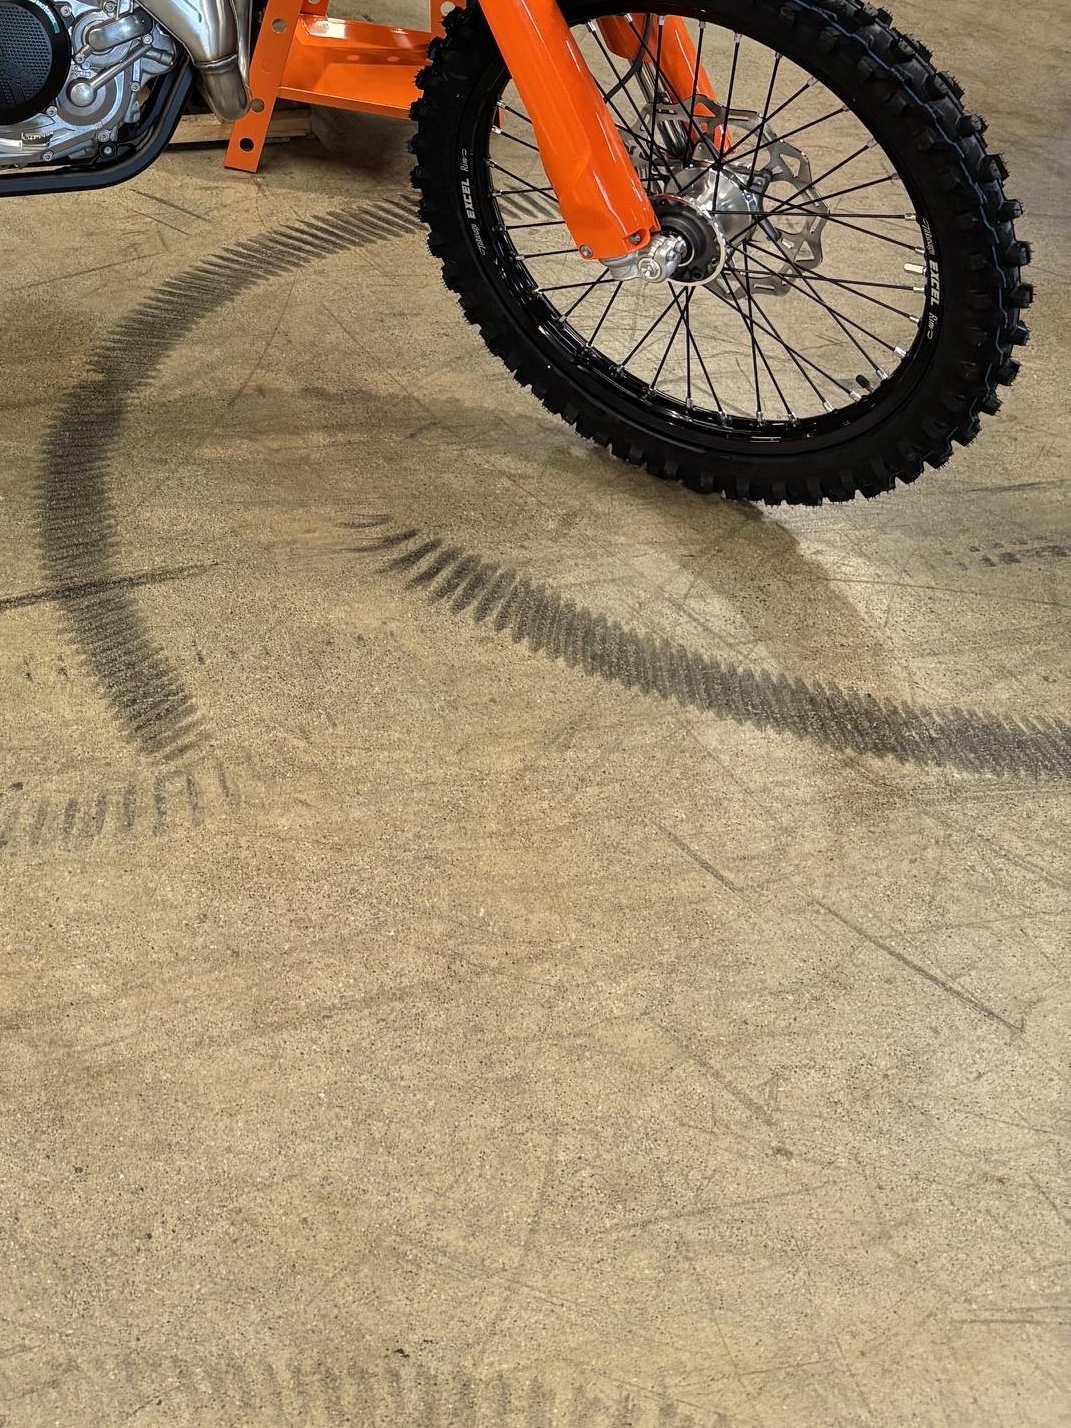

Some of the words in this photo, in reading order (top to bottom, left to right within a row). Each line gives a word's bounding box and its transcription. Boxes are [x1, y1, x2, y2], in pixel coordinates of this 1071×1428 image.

[460, 148, 469, 173] Rim
[461, 178, 476, 219] EXCEL
[929, 259, 940, 307] EXCEL
[927, 312, 938, 340] Rim
